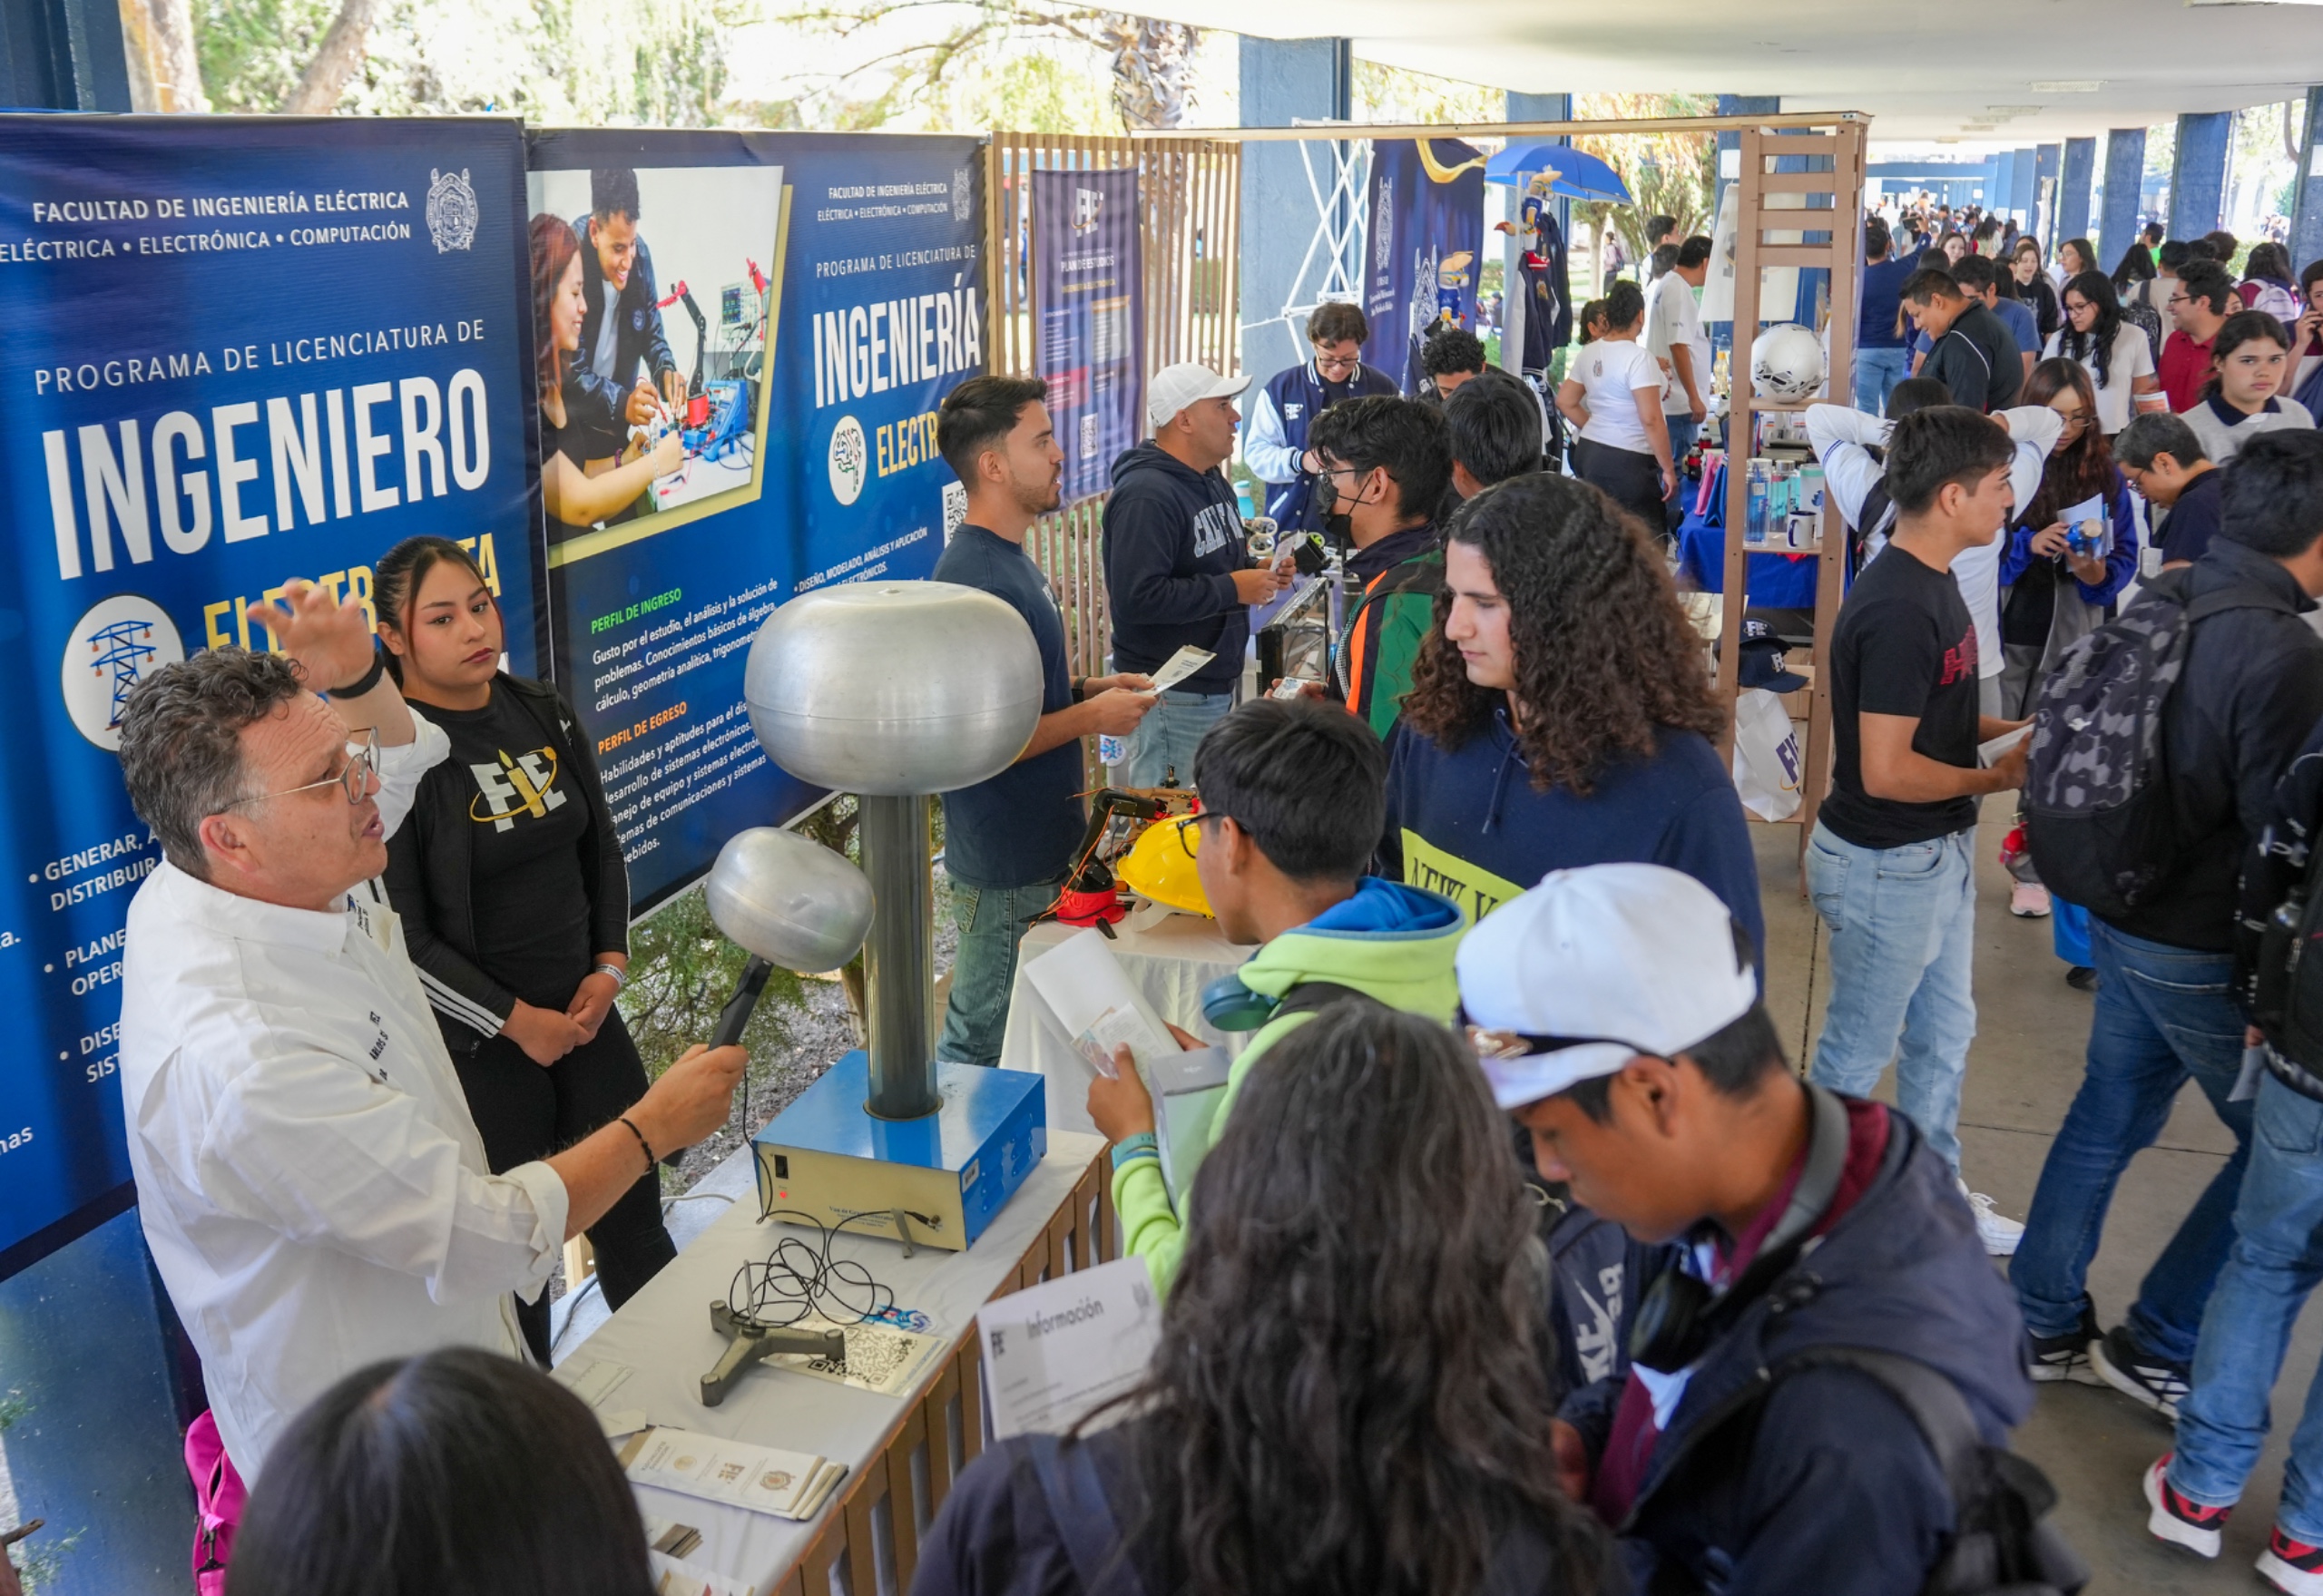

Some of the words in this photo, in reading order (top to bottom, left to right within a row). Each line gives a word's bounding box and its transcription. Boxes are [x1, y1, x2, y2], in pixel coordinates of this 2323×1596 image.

[33, 199, 150, 223] FACULTAD
[156, 198, 187, 219] DE
[192, 191, 309, 217] INGENIERÍA
[314, 189, 409, 212] ELÉCTRICA
[818, 207, 854, 222] ELÉCTRICA
[859, 204, 902, 219] ELECTRÓNICA
[907, 202, 948, 215] COMPUTACIÓN
[828, 185, 865, 200] FACULTAD
[866, 184, 876, 198] DE
[877, 182, 915, 197] INGENIERÍA
[915, 181, 948, 195] ELÉCTRICA
[0, 238, 116, 263] ELÉCTRICA
[139, 229, 271, 255] ELECTRÓNICA
[289, 220, 411, 246] COMPUTACIÓN
[816, 257, 877, 279] PROGRAMA
[879, 254, 893, 270] DE
[897, 246, 962, 268] LICENCIATURA
[965, 244, 976, 259] DE
[1060, 259, 1077, 272] PLAN
[1086, 255, 1115, 269] ESTUDIOS
[34, 351, 213, 396] PROGRAMA
[224, 345, 260, 372] DE
[271, 323, 448, 366] LICENCIATURA
[457, 319, 485, 343] DE
[813, 273, 982, 409] INGENIERÍA
[876, 399, 945, 478] ELECTR
[42, 368, 491, 581] INGENIERO
[799, 571, 827, 592] DISEÑO,
[826, 555, 864, 581] MODELADO,
[863, 543, 890, 563] ANÁLISIS
[895, 526, 928, 550] APLICACIÓN
[591, 611, 624, 634] PERFIL
[626, 605, 640, 622] DE
[641, 587, 682, 615] INGRESO
[593, 647, 622, 665] Gusto
[622, 637, 638, 657] por
[639, 630, 649, 646] el
[649, 620, 683, 643] estudio,
[683, 612, 692, 628] el
[693, 601, 722, 624] análisis
[721, 602, 729, 615] y
[728, 595, 737, 608] la
[737, 584, 768, 605] solución
[768, 578, 778, 591] de
[594, 659, 645, 692] problemas.
[645, 632, 707, 667] Conocimientos
[707, 620, 736, 639] básicos
[737, 612, 747, 625] de
[595, 687, 631, 712] cálculo,
[632, 667, 675, 700] geometría
[676, 651, 712, 676] analítica,
[712, 625, 760, 659] trigonomet
[598, 730, 632, 755] PERFIL
[634, 720, 648, 739] DE
[649, 701, 688, 730] EGRESO
[600, 748, 656, 785] Habilidades
[656, 747, 663, 760] y
[664, 724, 705, 753] aptitudes
[706, 714, 725, 734] para
[726, 706, 734, 720] el
[735, 701, 748, 717] dis
[651, 767, 663, 781] de
[664, 749, 701, 776] sistemas
[609, 802, 639, 827] anejo
[640, 794, 652, 810] de
[653, 778, 685, 803] equipo
[686, 775, 692, 788] y
[693, 753, 729, 781] sistemas
[616, 821, 645, 845] temas
[646, 813, 658, 829] de
[660, 778, 727, 821] comunicaciones
[727, 775, 733, 788] y
[733, 754, 767, 780] sistemas
[44, 833, 143, 881] GENERAR,
[623, 837, 661, 865] ebidos.
[50, 857, 157, 912] DISTRIBUIR
[64, 927, 126, 969] PLANE
[71, 960, 124, 996] OPER
[79, 1021, 121, 1056] DISE
[85, 1053, 121, 1083] SIST
[1026, 1297, 1104, 1341] Información
